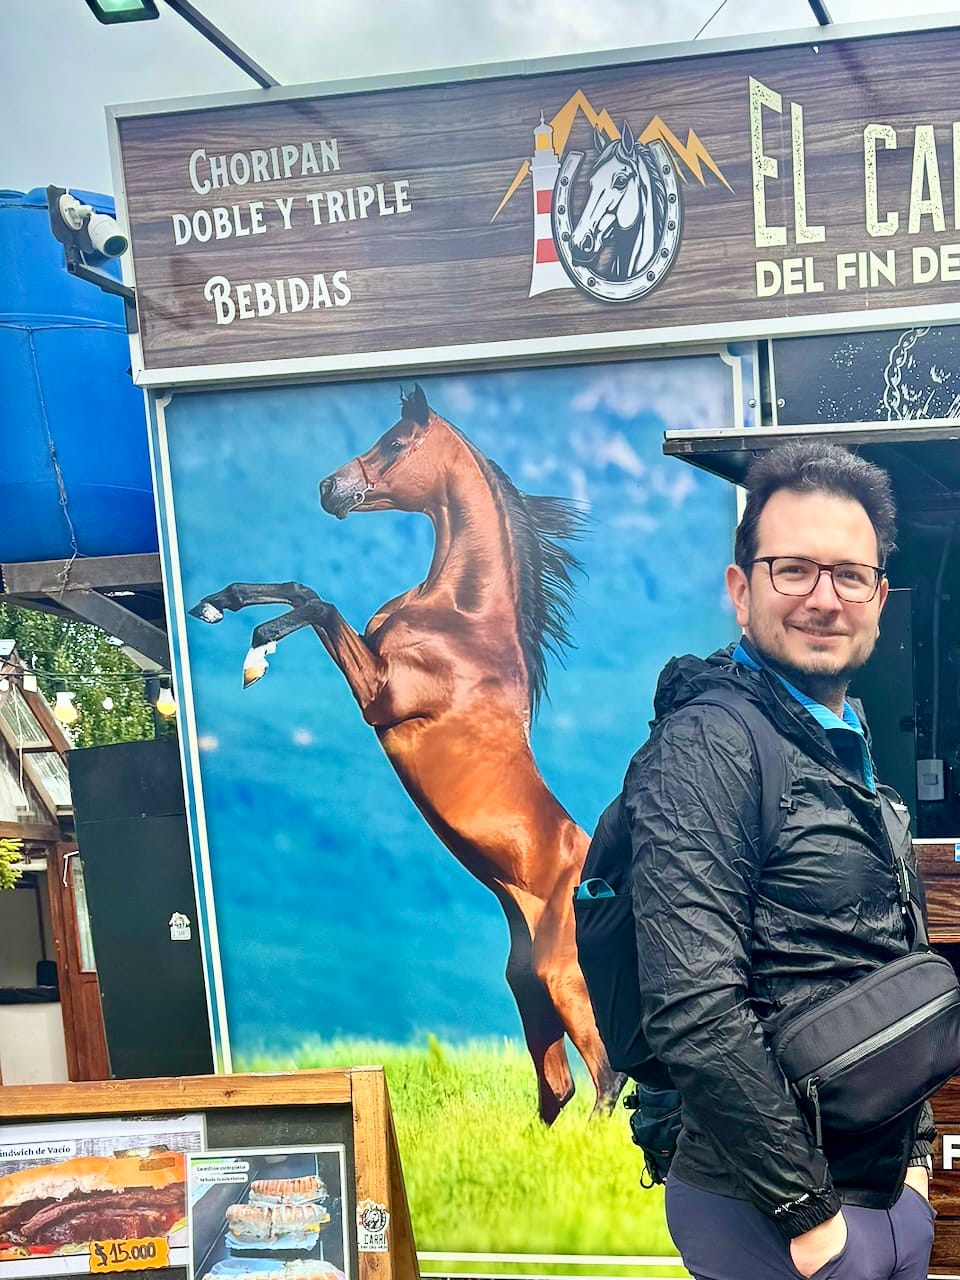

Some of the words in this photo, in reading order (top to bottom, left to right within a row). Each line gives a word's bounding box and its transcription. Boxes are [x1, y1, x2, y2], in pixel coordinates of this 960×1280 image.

[188, 138, 342, 196] CHORIPAN
[749, 76, 826, 248] EL
[172, 200, 268, 246] DOBLE
[278, 196, 296, 231] Y
[306, 180, 413, 226] TRIPLE
[203, 270, 353, 325] BEBIDAS
[755, 257, 826, 298] DEL
[836, 250, 897, 291] FIN
[36, 1147, 46, 1156] de
